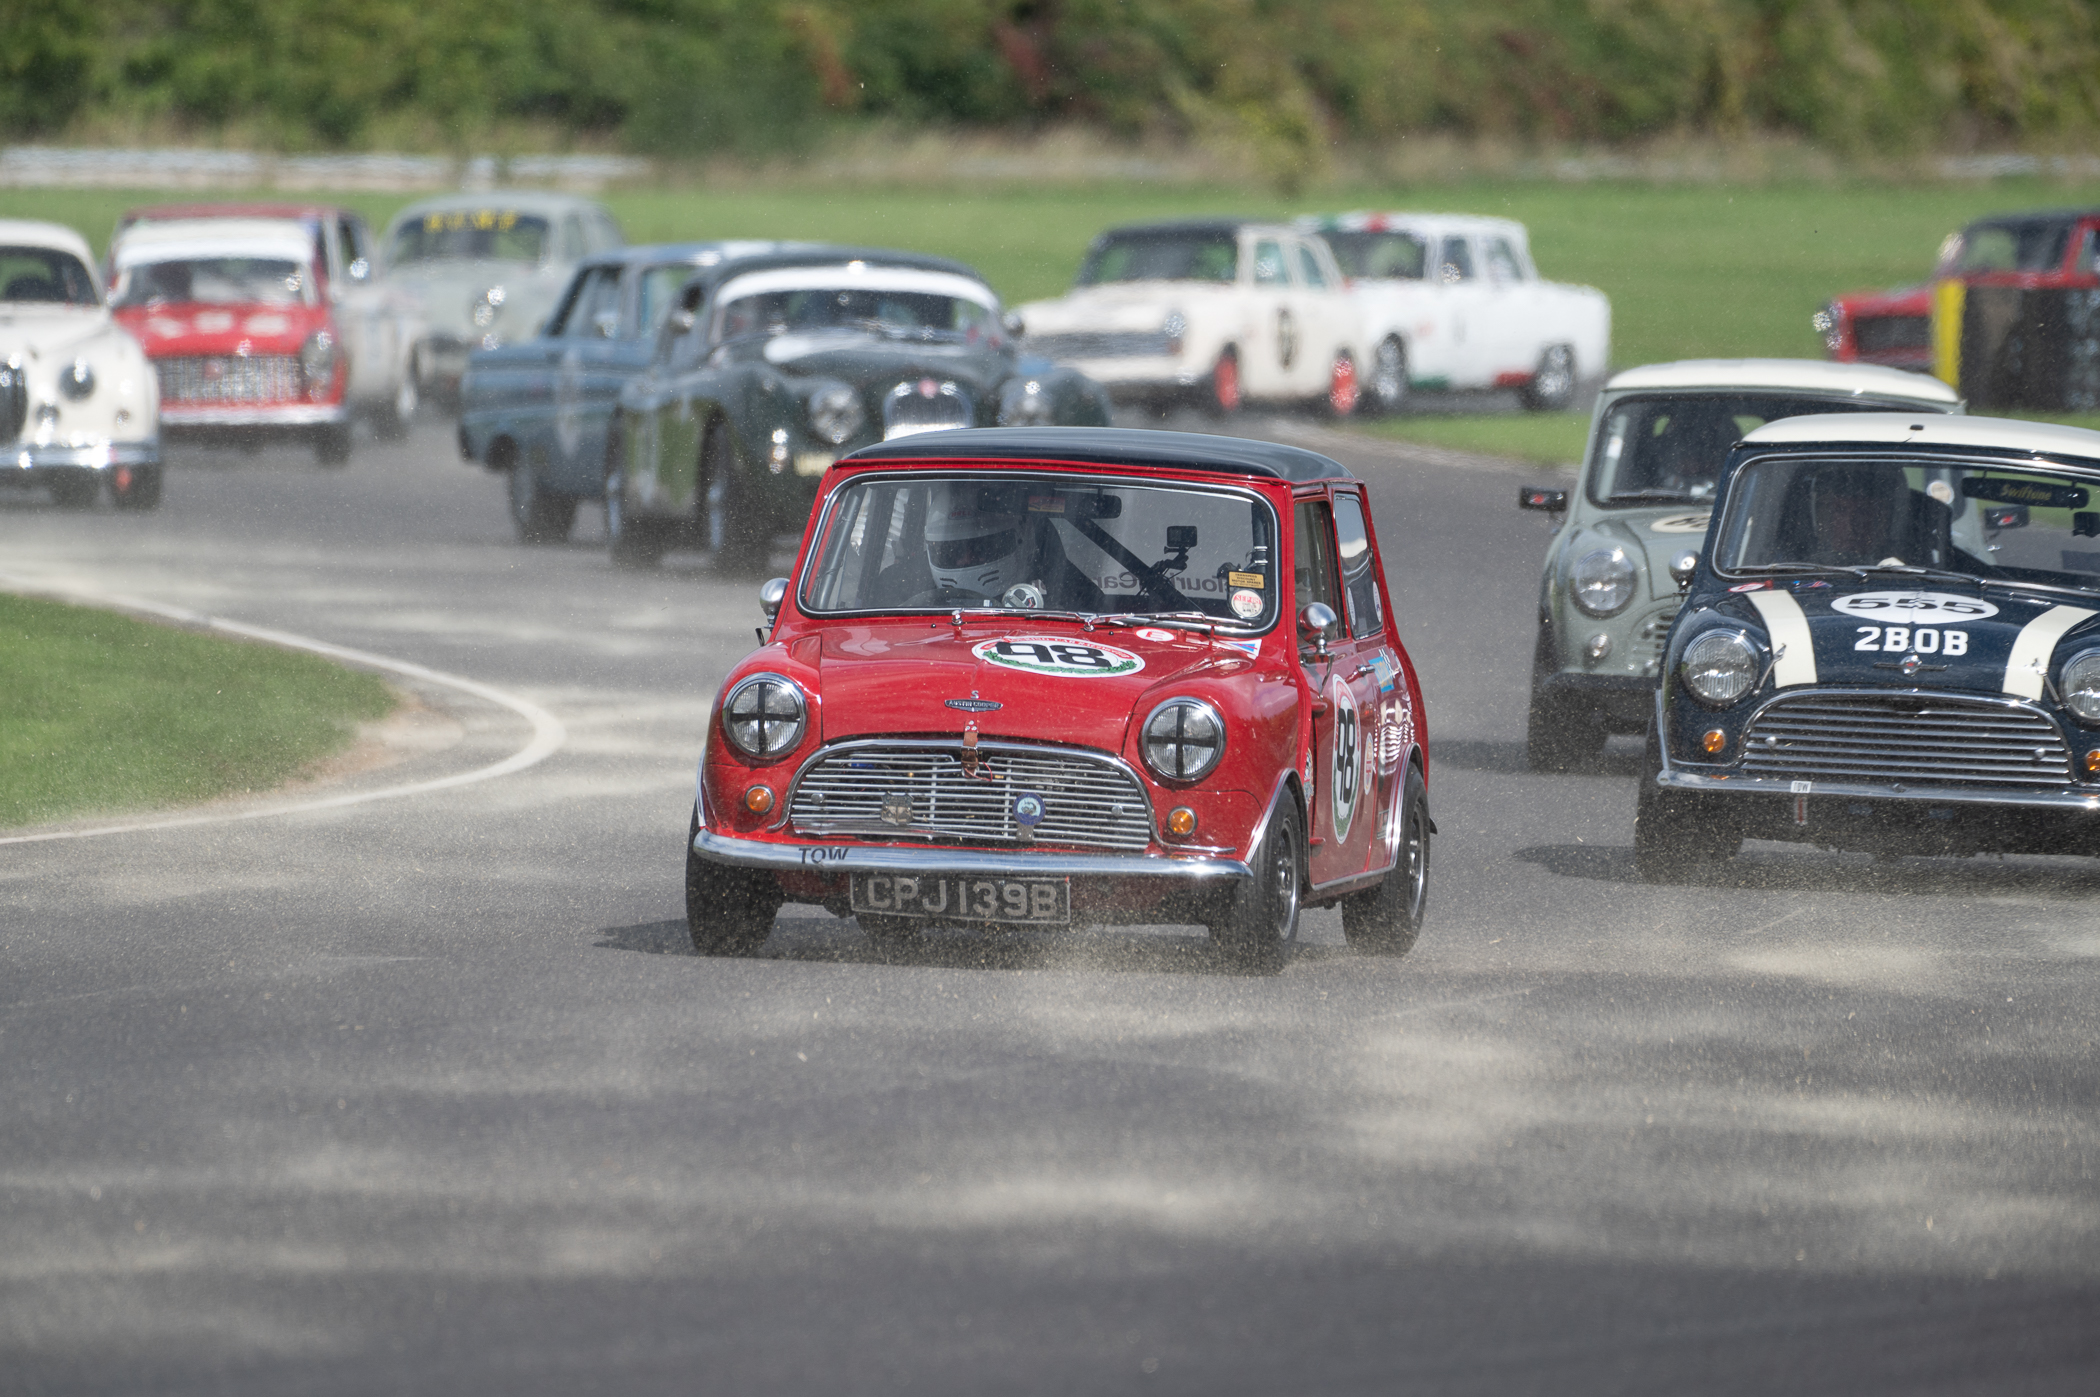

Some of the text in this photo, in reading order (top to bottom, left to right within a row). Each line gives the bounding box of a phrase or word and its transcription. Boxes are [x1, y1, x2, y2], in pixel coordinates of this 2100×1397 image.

[1846, 597, 1986, 615] 555
[1854, 626, 1969, 656] 2BOB
[995, 641, 1113, 667] 98
[970, 690, 979, 699] S
[1337, 707, 1356, 804] 98
[799, 847, 849, 865] TOW
